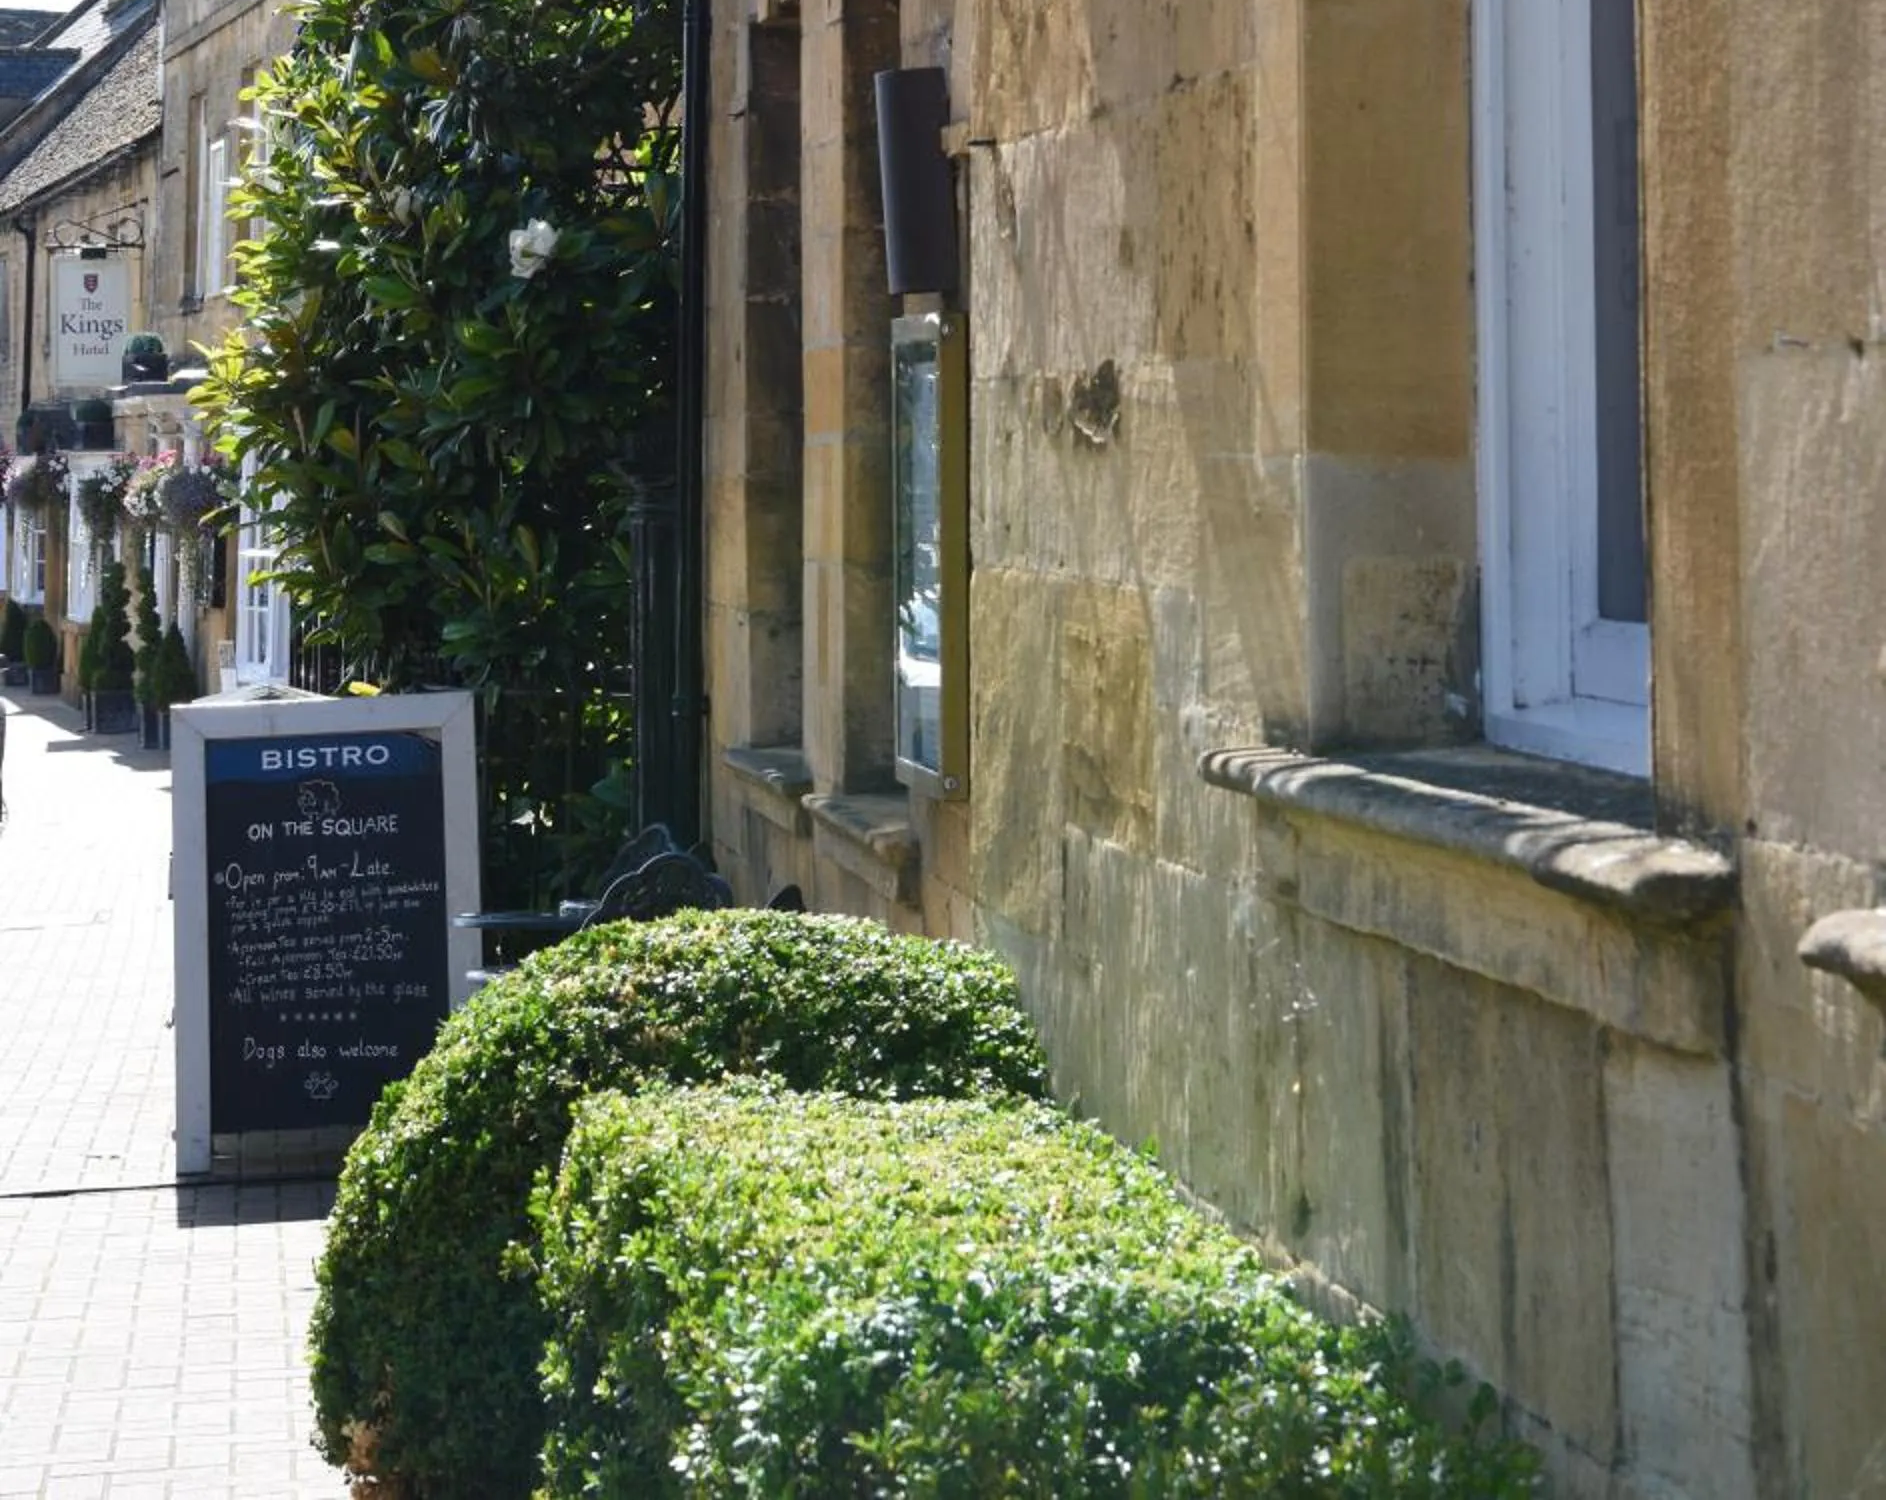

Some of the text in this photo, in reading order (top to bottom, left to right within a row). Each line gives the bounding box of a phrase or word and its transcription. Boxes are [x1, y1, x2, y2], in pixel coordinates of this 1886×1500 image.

[80, 297, 103, 311] The
[61, 313, 124, 341] Kings
[73, 343, 110, 356] Hotel
[261, 744, 390, 770] BISTRO
[247, 813, 399, 841] ON THE SQUARE
[226, 862, 265, 894] Open
[244, 1036, 399, 1069] Dogs also welcome
